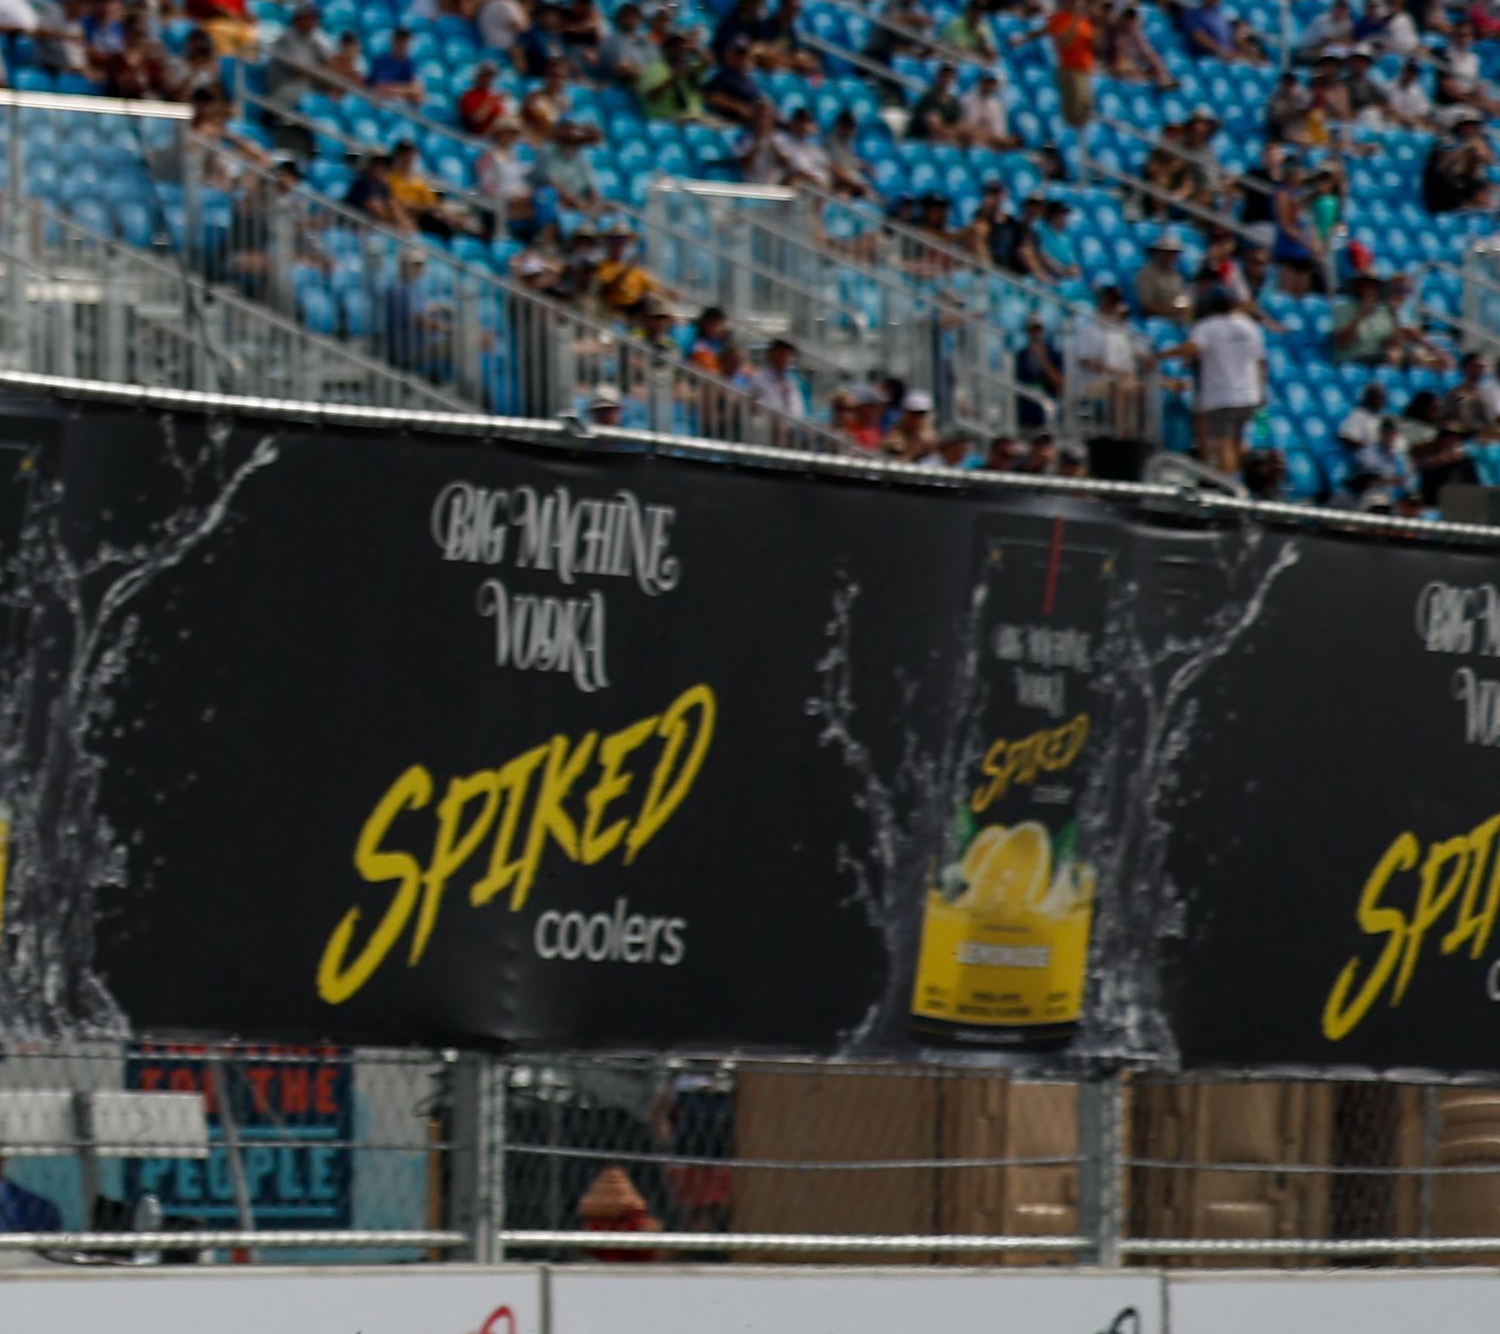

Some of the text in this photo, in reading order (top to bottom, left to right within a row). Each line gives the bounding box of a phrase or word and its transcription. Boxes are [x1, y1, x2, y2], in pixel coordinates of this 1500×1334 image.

[430, 480, 681, 594] BIG MACHINE
[477, 581, 610, 692] VODKA
[970, 713, 1091, 813] SPIKED
[316, 683, 717, 1007] SPIKED
[534, 900, 686, 968] coolers
[248, 1068, 340, 1114] THE
[140, 1147, 338, 1199] PEOPLE
